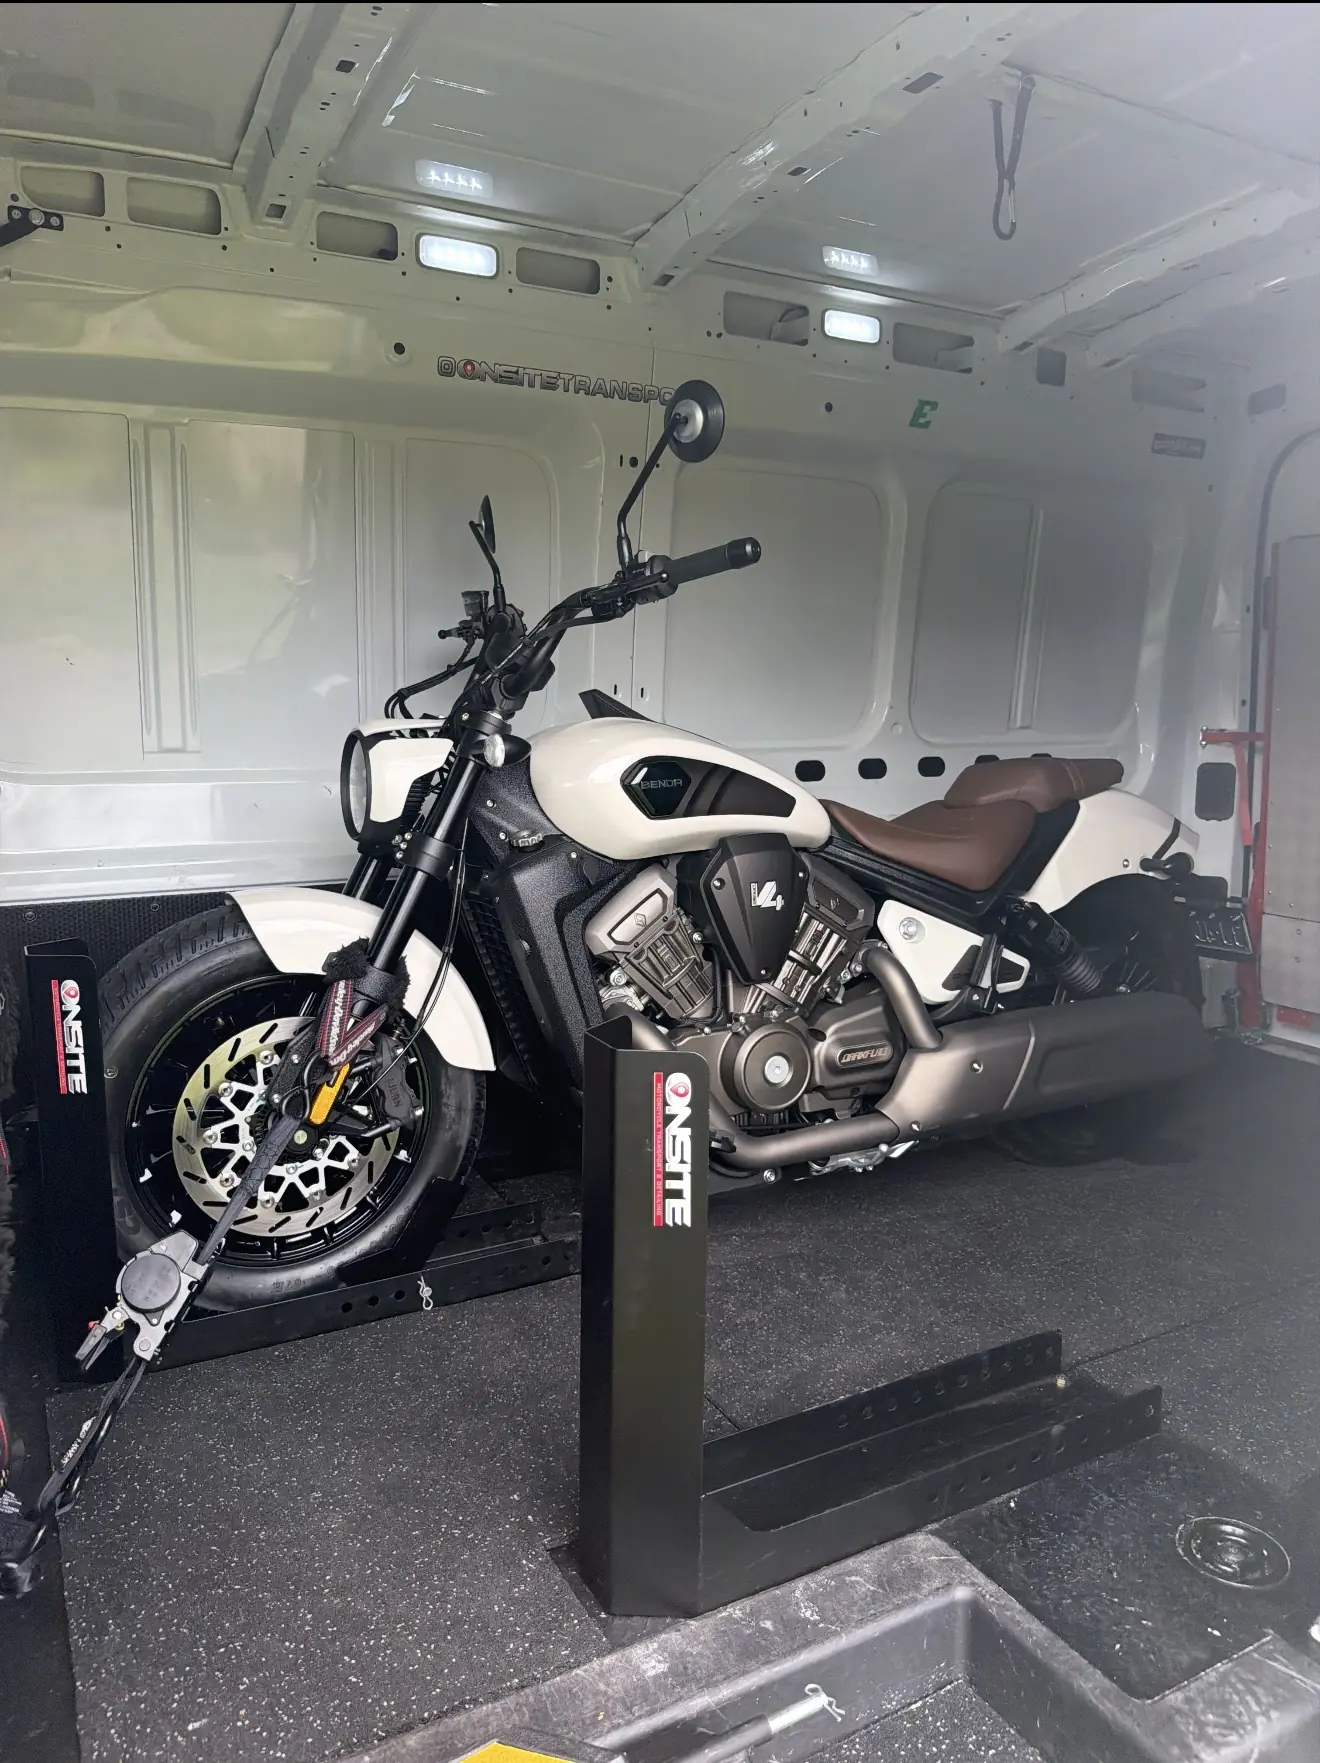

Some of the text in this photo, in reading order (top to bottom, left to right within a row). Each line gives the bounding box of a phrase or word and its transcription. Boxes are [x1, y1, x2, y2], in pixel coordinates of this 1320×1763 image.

[908, 398, 938, 429] E
[641, 778, 683, 790] BENDA
[61, 979, 88, 1094] ONSITE
[665, 1072, 692, 1228] ONSITE
